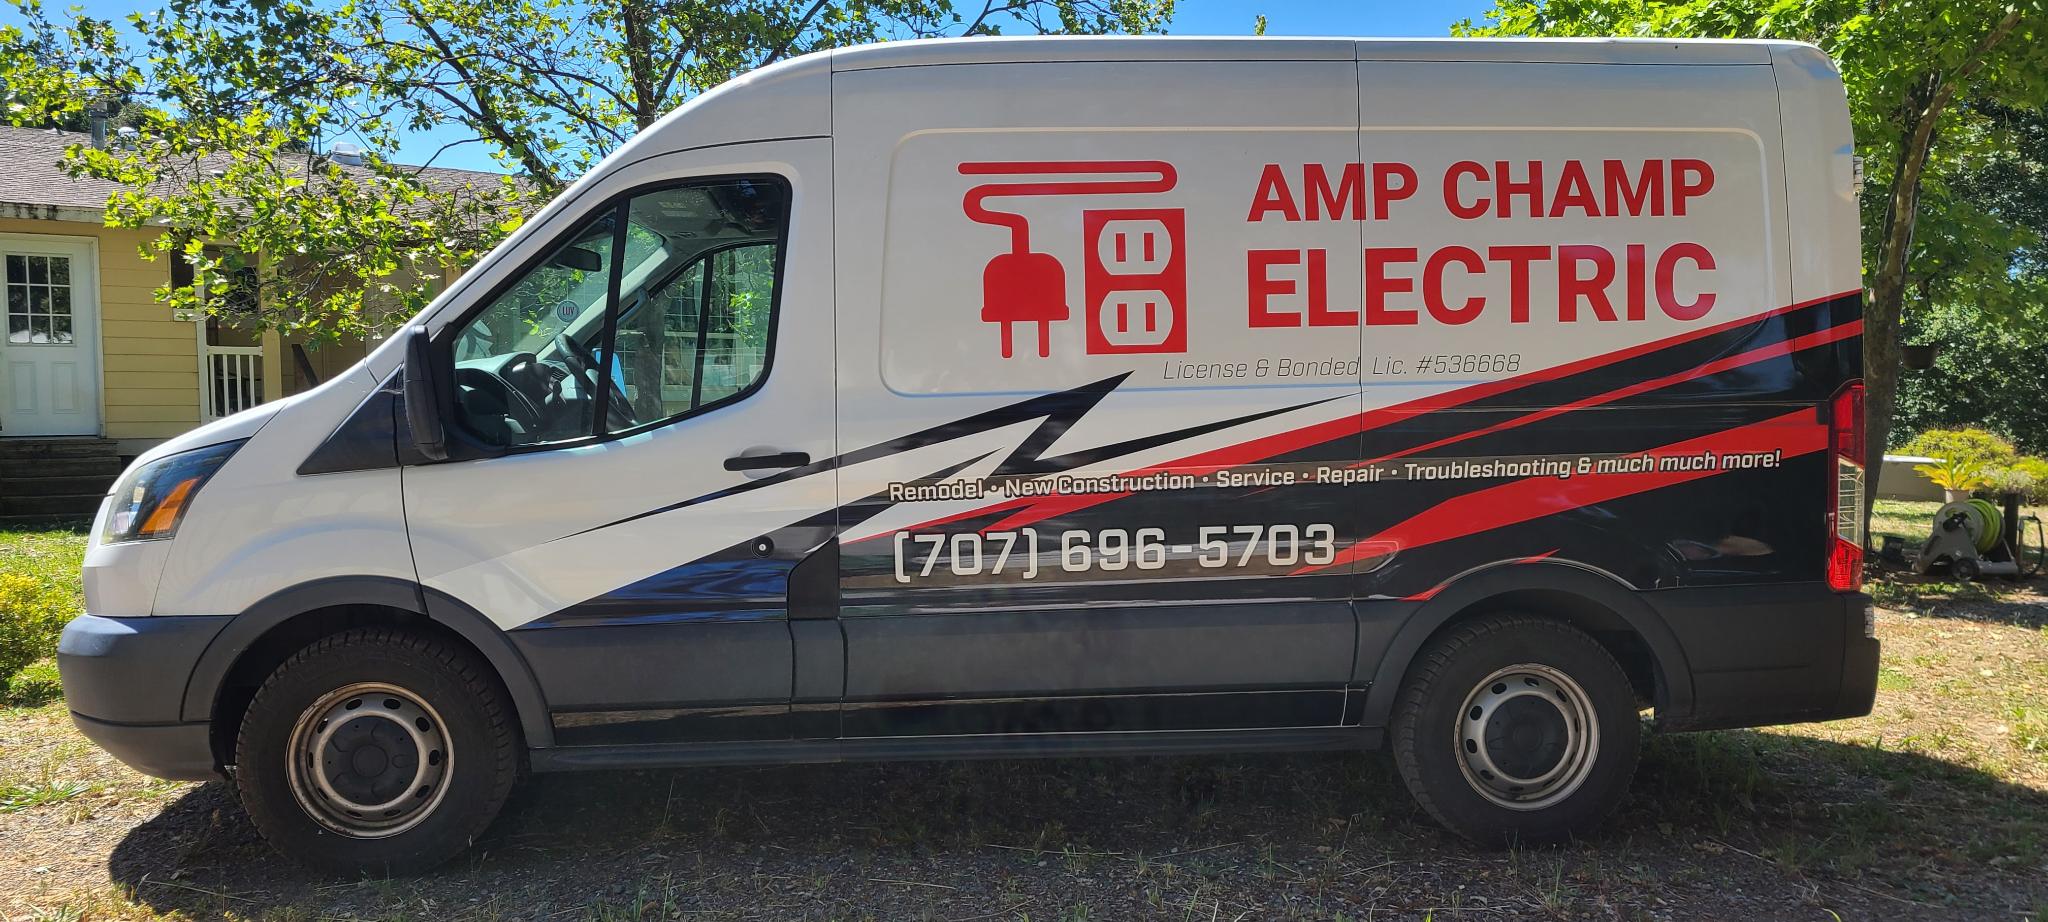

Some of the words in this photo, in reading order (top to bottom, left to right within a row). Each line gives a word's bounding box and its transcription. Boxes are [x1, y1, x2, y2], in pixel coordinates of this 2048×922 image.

[1247, 162, 1418, 222] AMP
[1443, 159, 1715, 219] CHAMP
[1247, 242, 1716, 328] ELECTRIC
[1163, 359, 1247, 380] License
[1255, 359, 1269, 378] &
[1277, 356, 1360, 377] Bonded
[1372, 356, 1407, 375] Lic.
[1416, 353, 1522, 374] #536668
[889, 479, 984, 502] Remodel
[1005, 476, 1054, 498] New
[1057, 472, 1195, 496] Construction
[1216, 469, 1295, 488] Service
[1316, 465, 1385, 486] Repair
[1405, 457, 1572, 482] Troubleshooting
[1576, 457, 1592, 476] &
[1597, 454, 1655, 474] much
[1658, 452, 1717, 471] much
[1722, 449, 1782, 470] more!
[894, 527, 1038, 583] (707)
[1061, 523, 1336, 572] 696-5703
